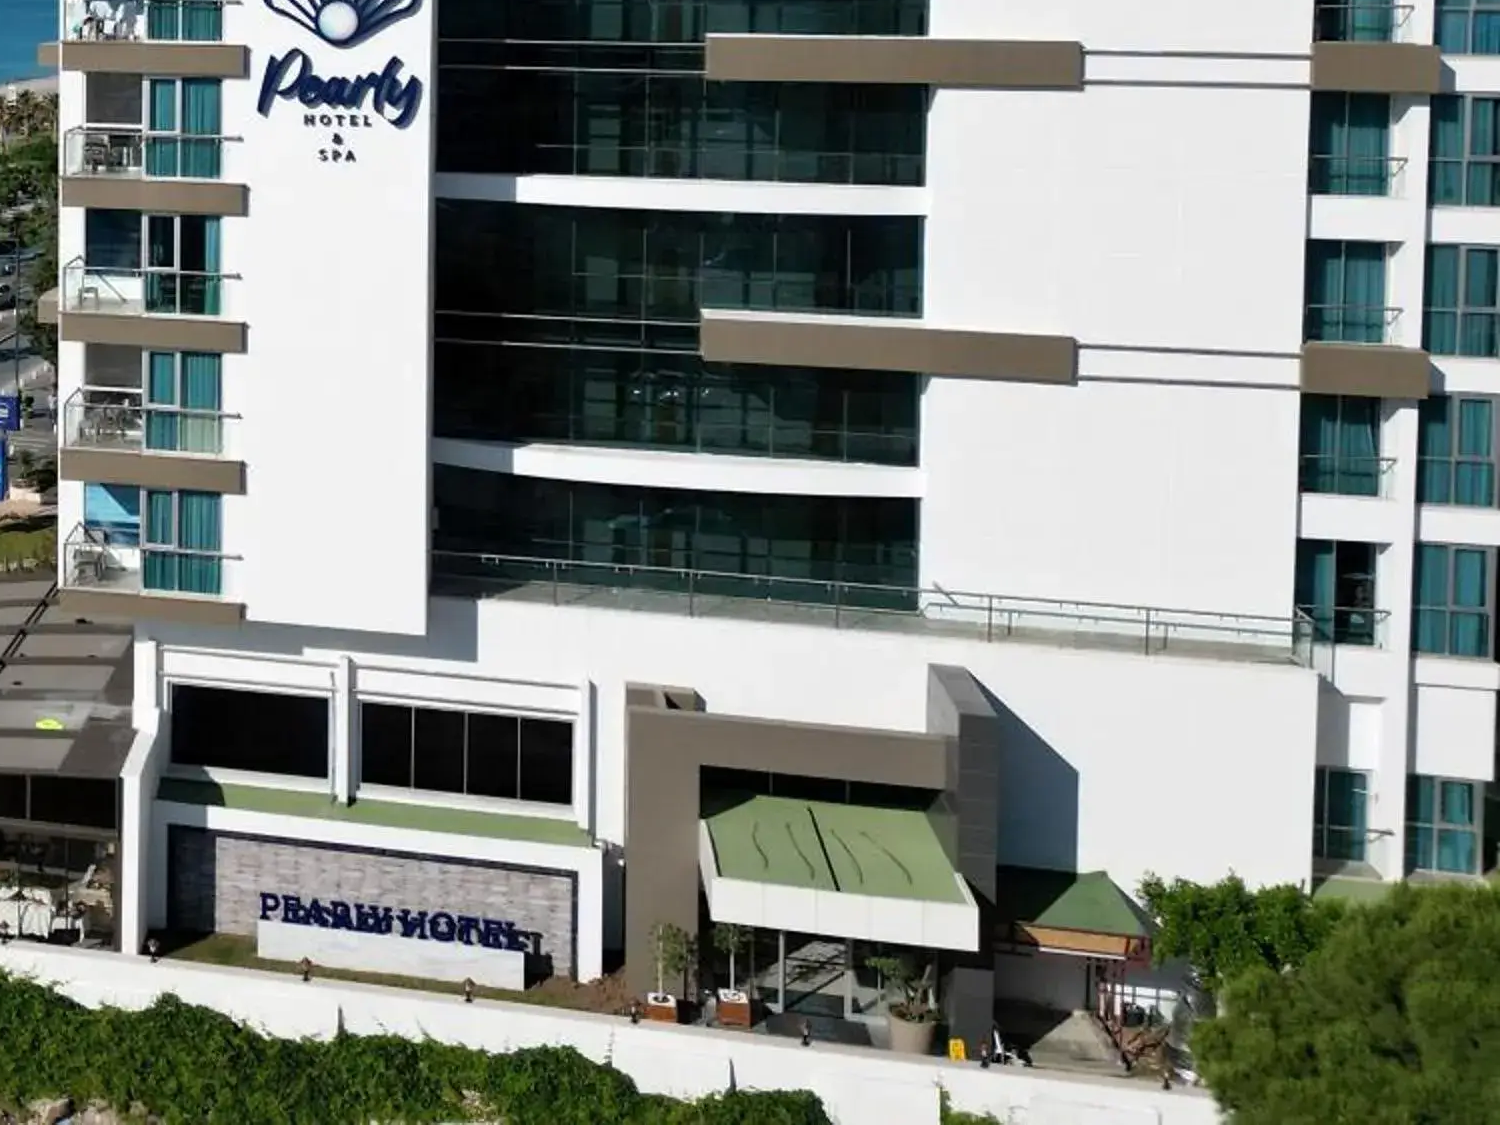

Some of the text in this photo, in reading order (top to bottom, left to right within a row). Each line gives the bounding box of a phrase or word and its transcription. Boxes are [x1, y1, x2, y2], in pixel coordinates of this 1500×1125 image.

[257, 48, 423, 130] Pearly
[303, 114, 373, 128] HOTEL
[331, 133, 344, 145] &
[318, 149, 357, 163] SPA
[259, 892, 525, 952] PEARLY HOTEL
